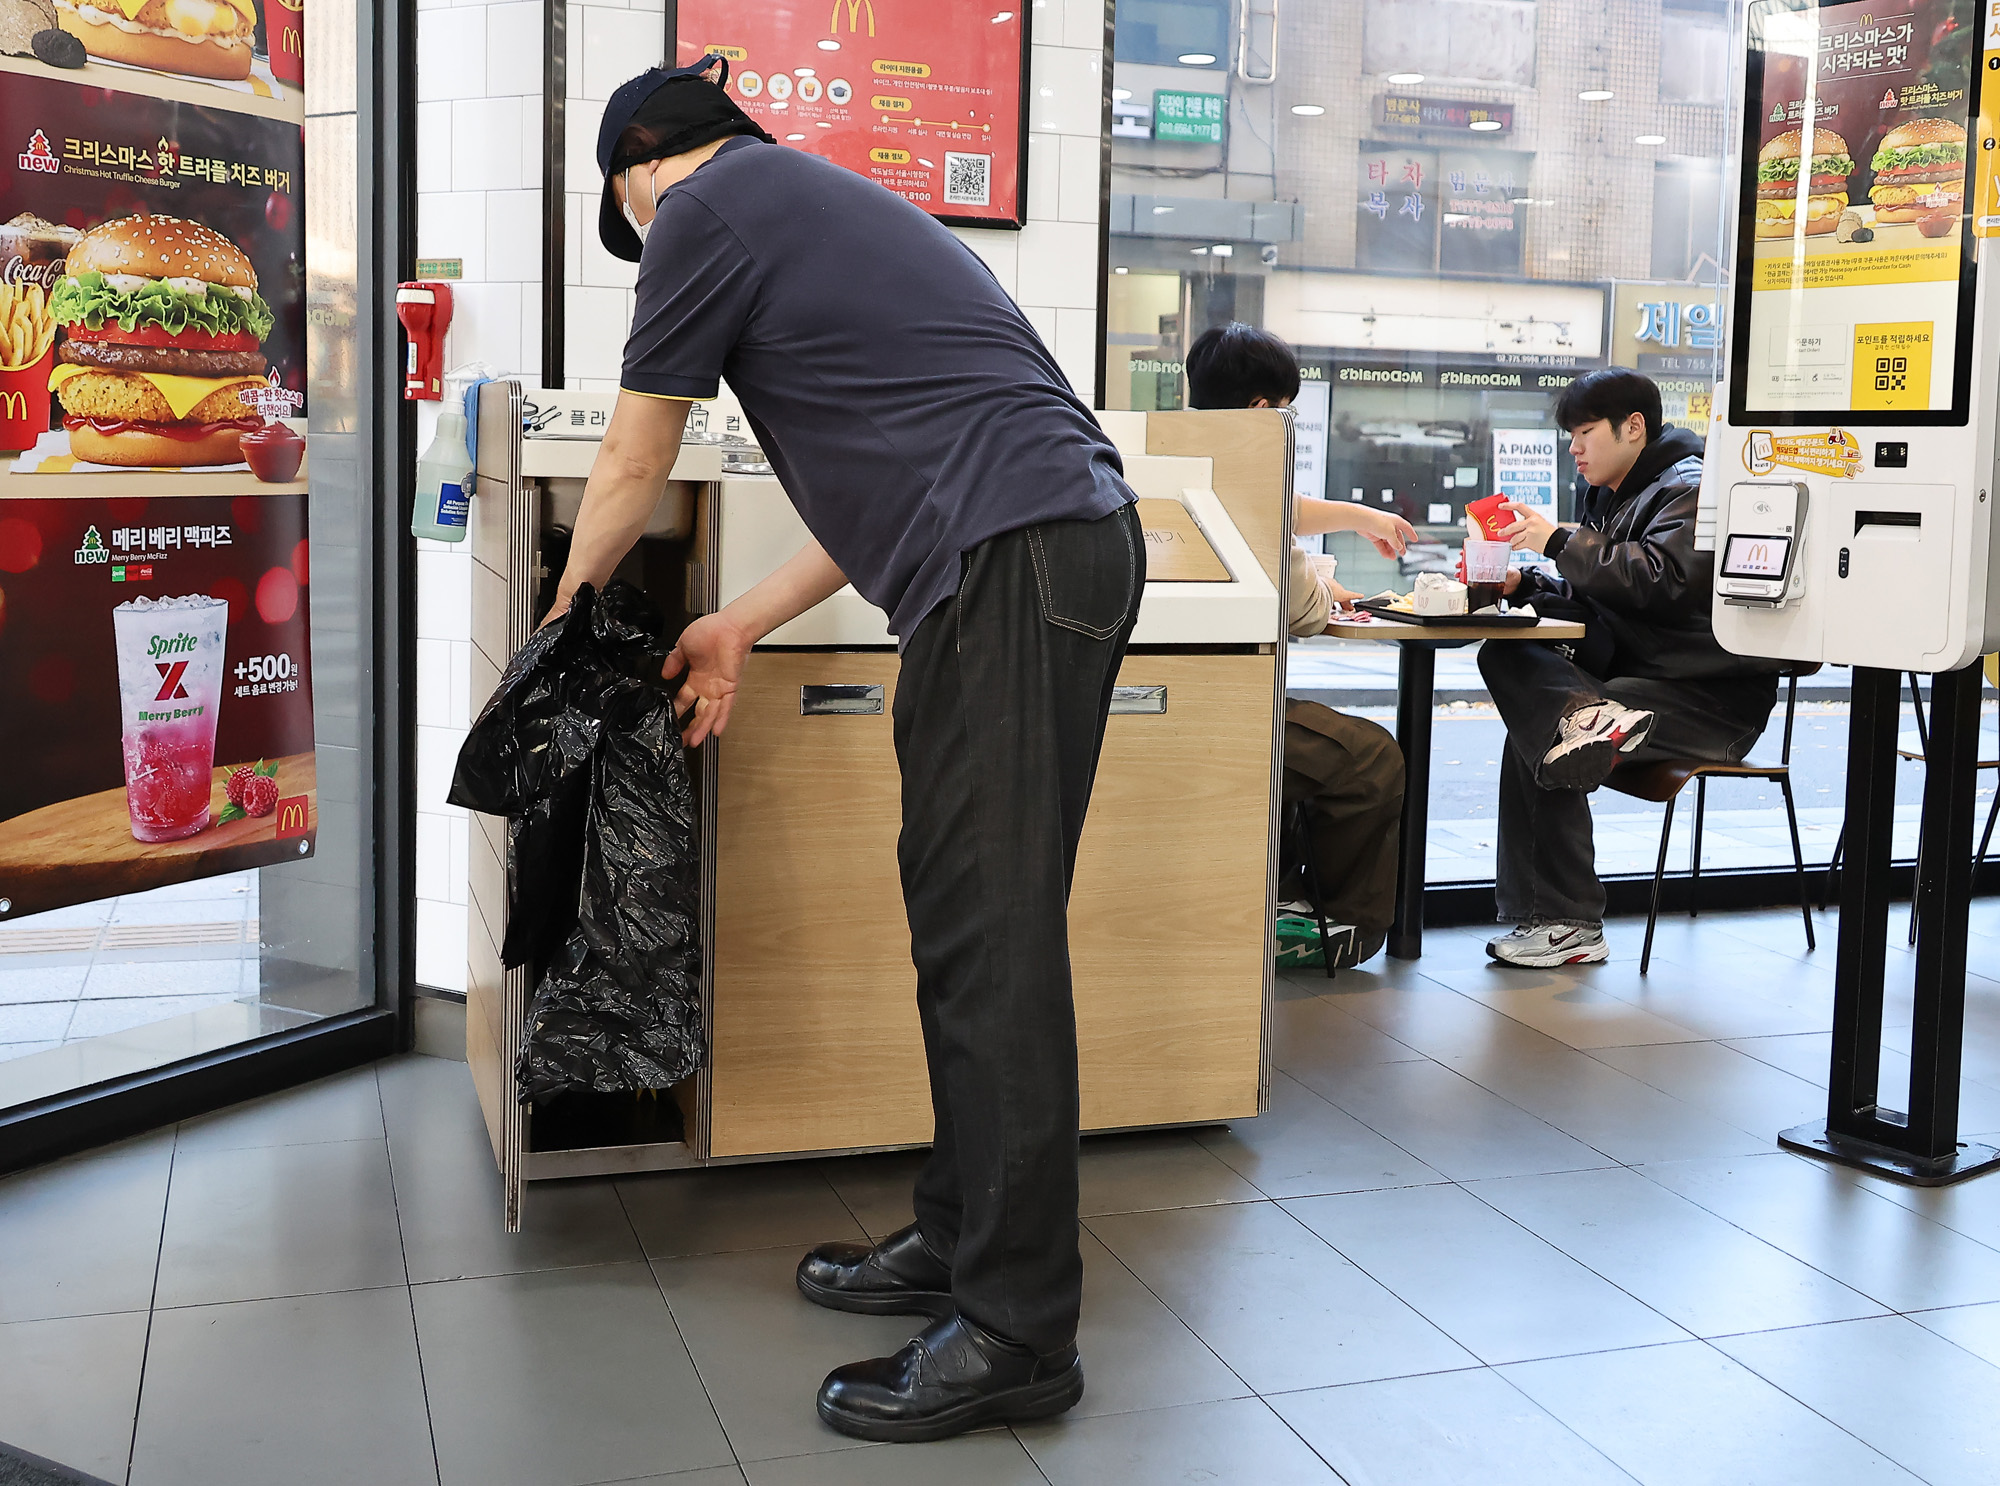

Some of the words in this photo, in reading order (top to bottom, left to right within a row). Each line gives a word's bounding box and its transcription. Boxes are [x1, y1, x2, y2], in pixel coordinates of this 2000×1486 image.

[1818, 22, 1914, 52] 크리스마스가
[1822, 49, 1884, 74] 시작되는
[1886, 44, 1908, 66] 맛!
[1900, 83, 1939, 96] 크리스마스
[1908, 93, 1932, 105] 트러플
[1931, 92, 1948, 103] 치즈
[1947, 89, 1964, 101] 버거
[1824, 104, 1839, 115] 버거
[1879, 99, 1898, 110] new
[1769, 113, 1786, 123] new
[20, 155, 59, 173] new
[63, 138, 154, 170] 크리스마스
[157, 151, 175, 176] 핫
[178, 155, 227, 184] 트러플
[230, 163, 262, 187] 치즈
[264, 169, 290, 194] 버거
[63, 165, 99, 178] Christmas
[100, 170, 112, 180] Hot
[112, 171, 134, 183] Truffle
[134, 174, 159, 186] Cheese
[159, 178, 181, 189] Burger
[870, 167, 894, 176] 맥도날드
[883, 178, 896, 186] 바로
[1857, 335, 1888, 344] 포인트를
[1889, 333, 1930, 344] 적립하세요
[1661, 357, 1680, 369] TEL
[240, 389, 273, 404] 매콤~한
[273, 388, 303, 407] 핫소스를
[726, 415, 740, 431] 컵
[1499, 444, 1507, 455] A
[1510, 444, 1552, 455] PIANO
[1810, 447, 1836, 457] 편리하게
[1816, 458, 1846, 469] 챙기세요!
[112, 527, 145, 551] 메리
[148, 526, 182, 550] 베리
[184, 525, 233, 548] 맥피즈
[75, 550, 109, 563] new
[111, 554, 130, 563] Merry
[130, 553, 147, 562] Berry
[147, 552, 168, 560] McFizz
[147, 632, 198, 659] Sprite
[234, 685, 250, 698] 세트
[251, 683, 268, 697] 음료
[268, 681, 283, 695] 변경
[282, 680, 298, 693] 가능!
[138, 710, 172, 722] Merry
[173, 705, 204, 720] Berry
